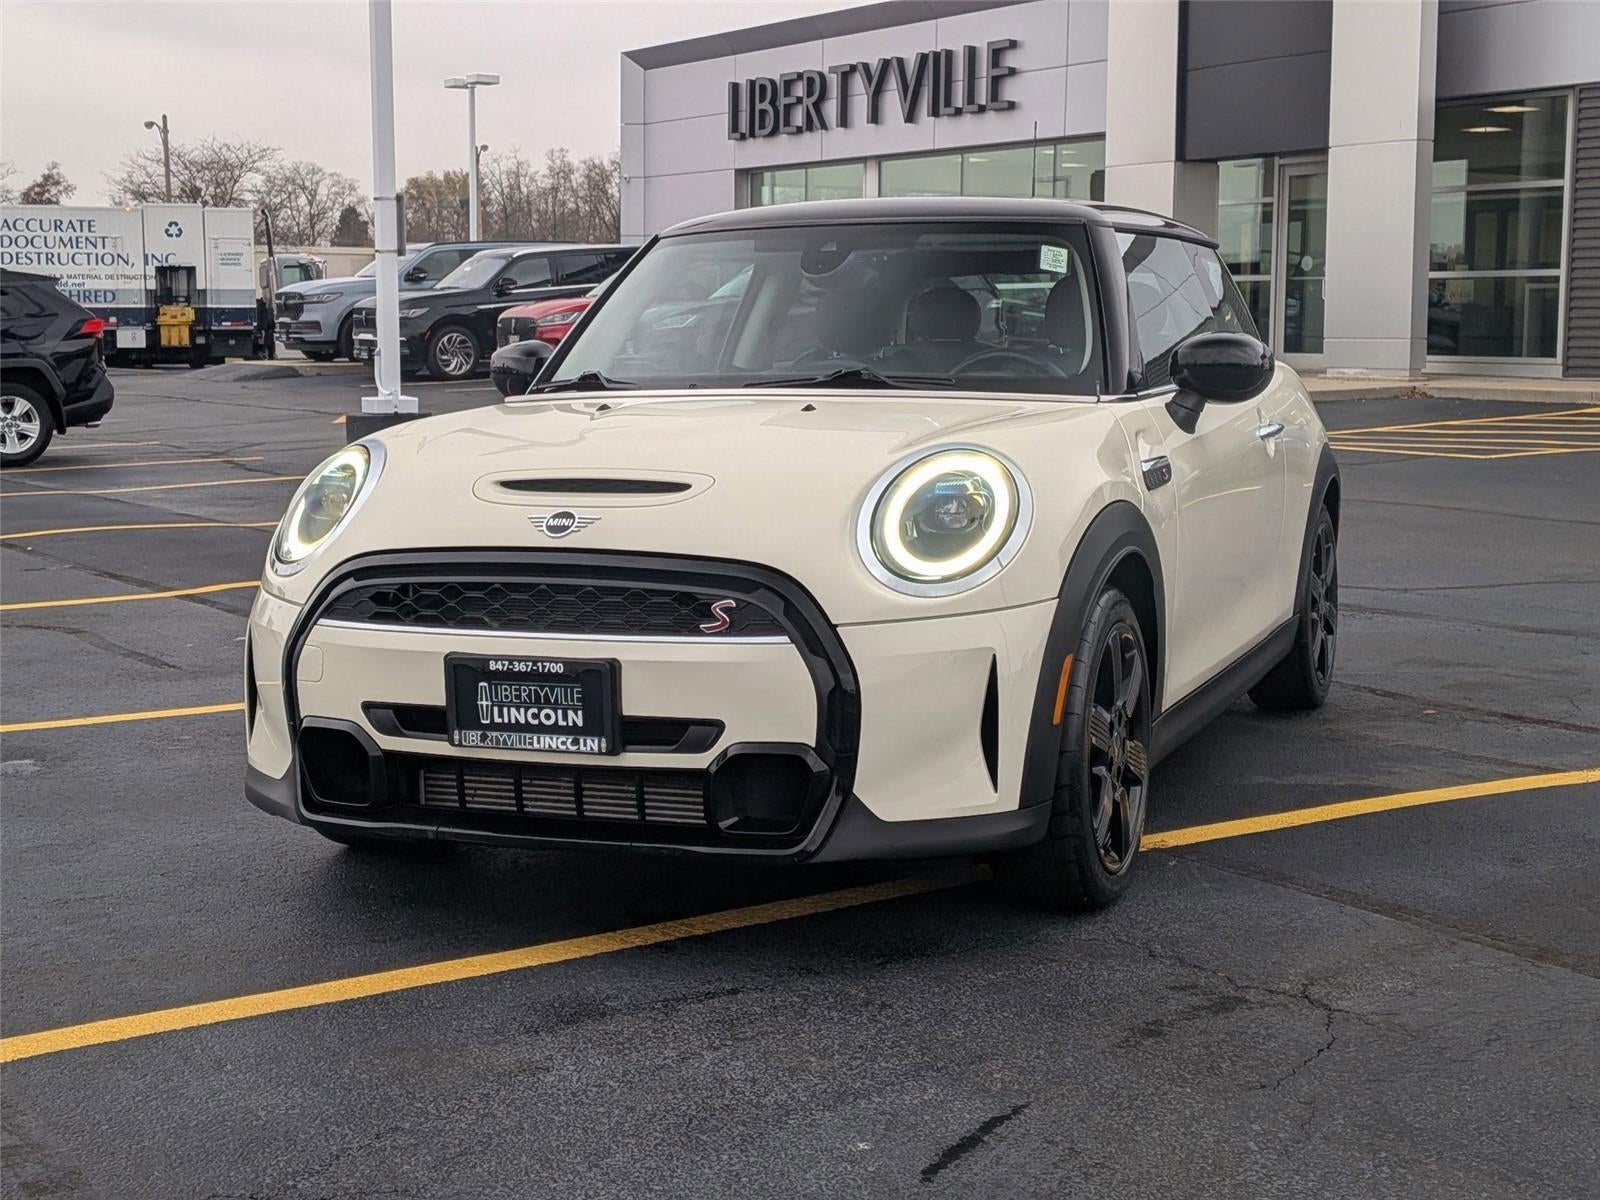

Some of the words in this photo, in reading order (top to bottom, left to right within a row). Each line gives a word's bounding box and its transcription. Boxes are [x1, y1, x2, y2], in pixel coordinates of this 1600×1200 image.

[728, 39, 1017, 140] LIBERTYVILLE
[0, 218, 96, 233] ACCURATE
[0, 234, 109, 249] DOCUMENT
[66, 273, 103, 281] MATERIAL
[60, 289, 117, 304] HRED
[547, 517, 574, 527] MINI
[699, 599, 736, 634] S
[489, 660, 564, 674] 847-367-1700
[492, 684, 582, 706] LIBERTYVILLE
[493, 706, 584, 727] LINCOLN
